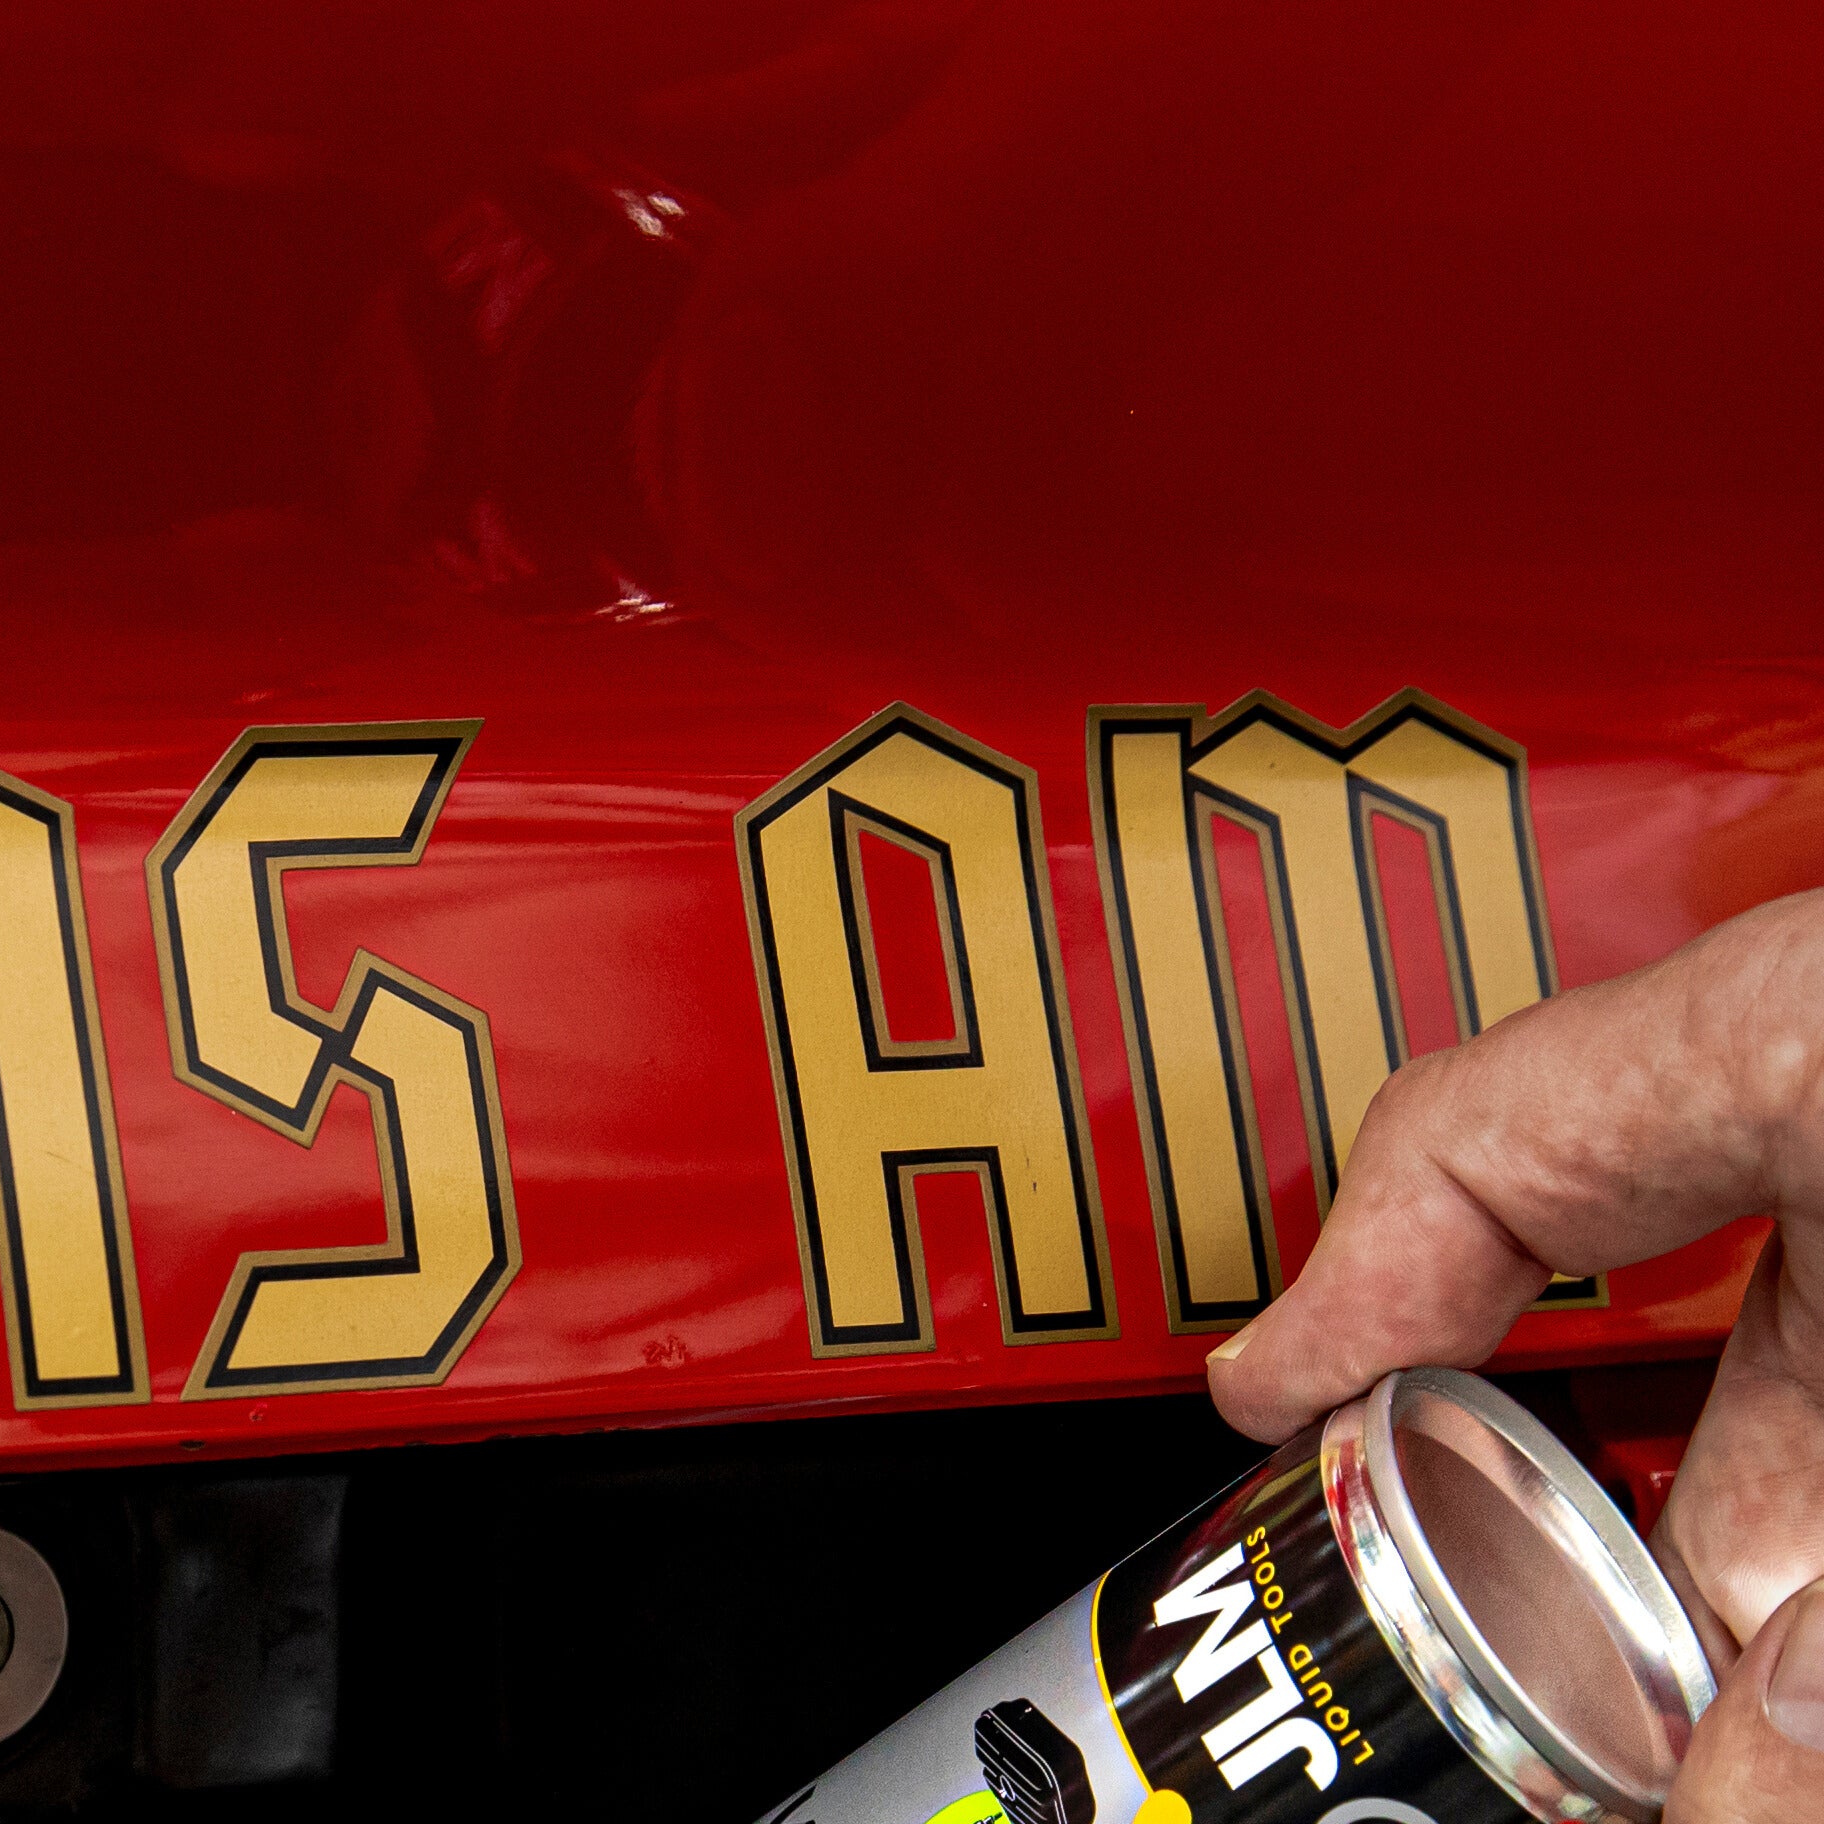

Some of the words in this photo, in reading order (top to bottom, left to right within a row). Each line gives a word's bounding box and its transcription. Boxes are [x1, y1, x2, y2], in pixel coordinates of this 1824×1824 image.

[735, 687, 1607, 1356] AM
[1152, 1541, 1336, 1790] JLM
[1245, 1526, 1292, 1634] TOOLS
[1288, 1646, 1375, 1765] LIQUID
